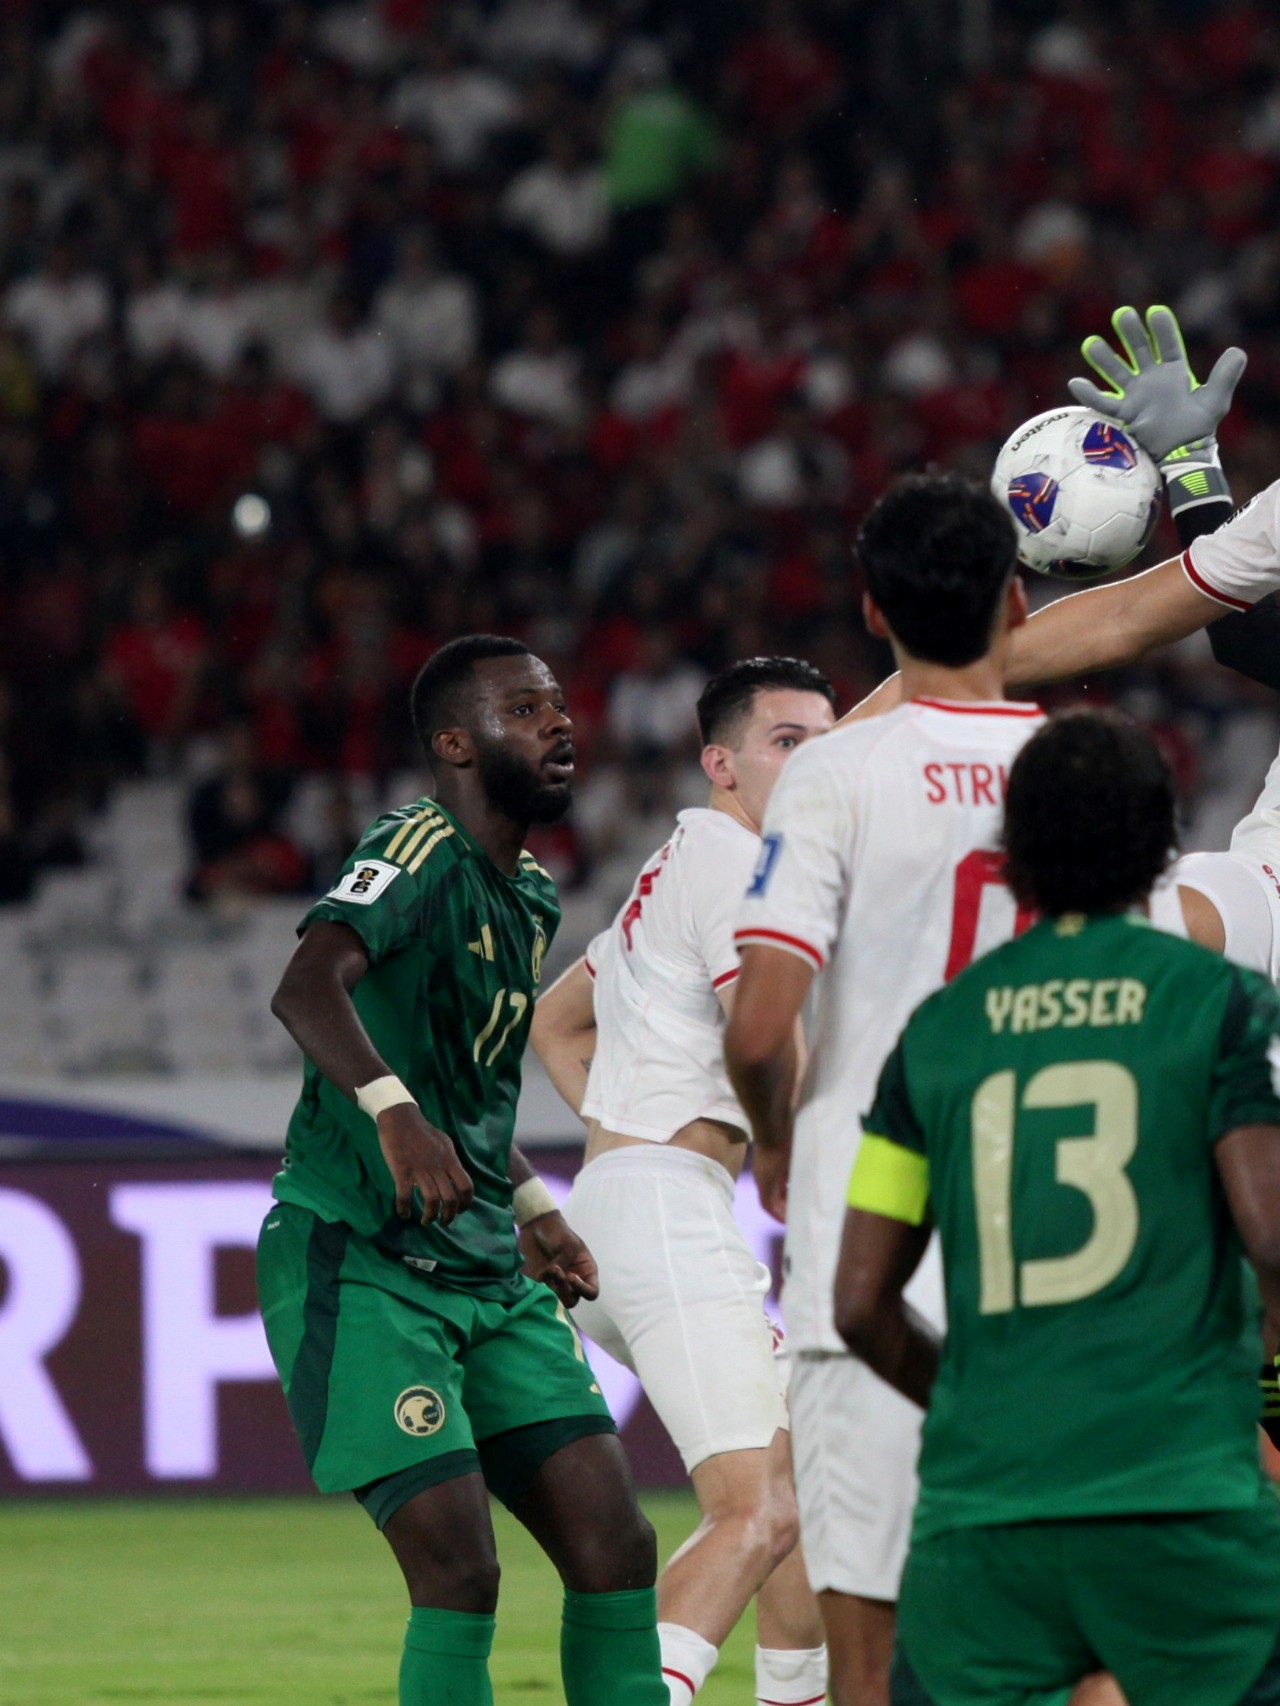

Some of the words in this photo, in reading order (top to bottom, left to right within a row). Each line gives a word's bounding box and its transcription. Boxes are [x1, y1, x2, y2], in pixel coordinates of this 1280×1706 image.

[1011, 412, 1069, 452] molten
[473, 988, 527, 1067] 17
[985, 977, 1147, 1034] YASSER
[971, 1059, 1139, 1315] 13
